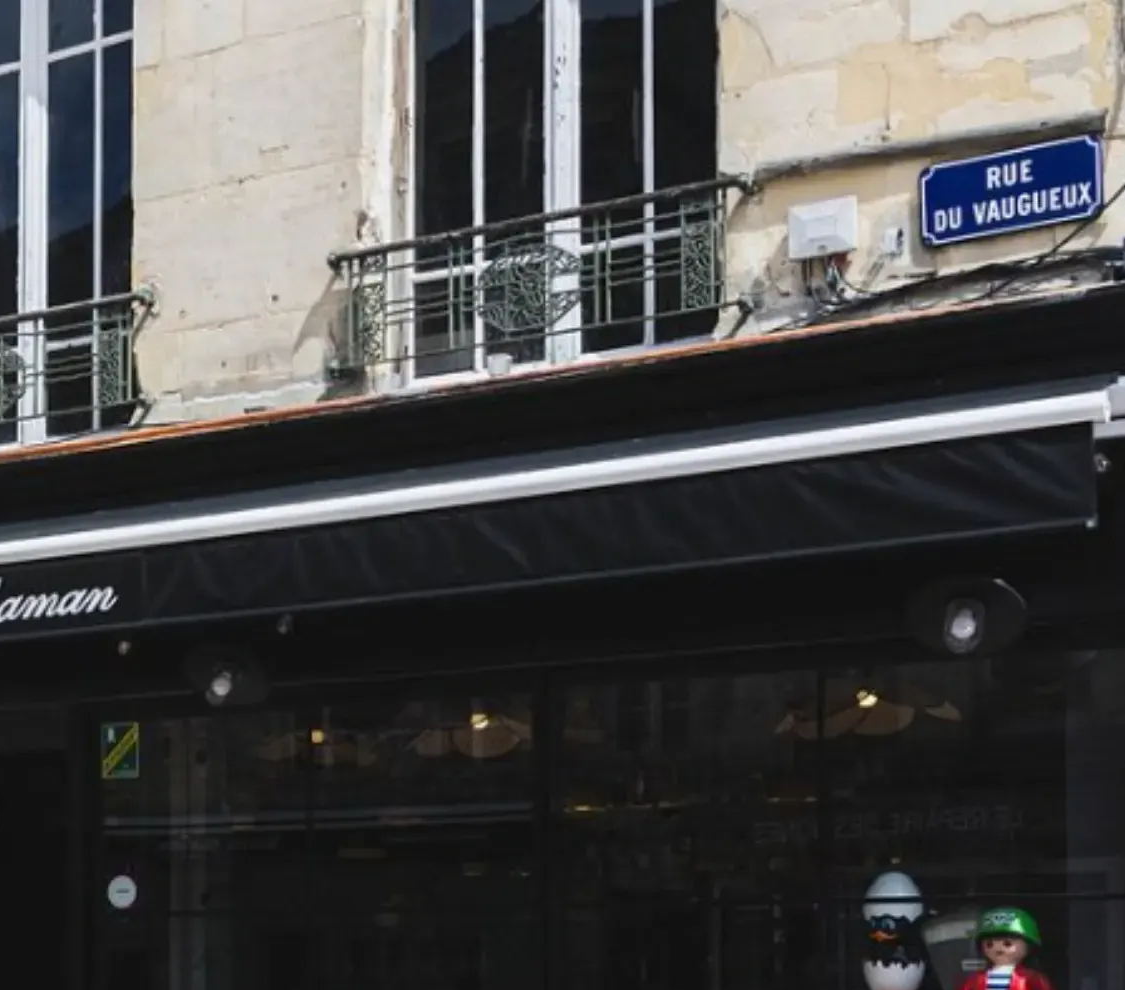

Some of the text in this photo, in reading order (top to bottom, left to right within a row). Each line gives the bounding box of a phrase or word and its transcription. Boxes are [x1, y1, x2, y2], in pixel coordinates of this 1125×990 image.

[986, 159, 1034, 190] RUE
[933, 181, 1093, 233] DU VAUGUEUX
